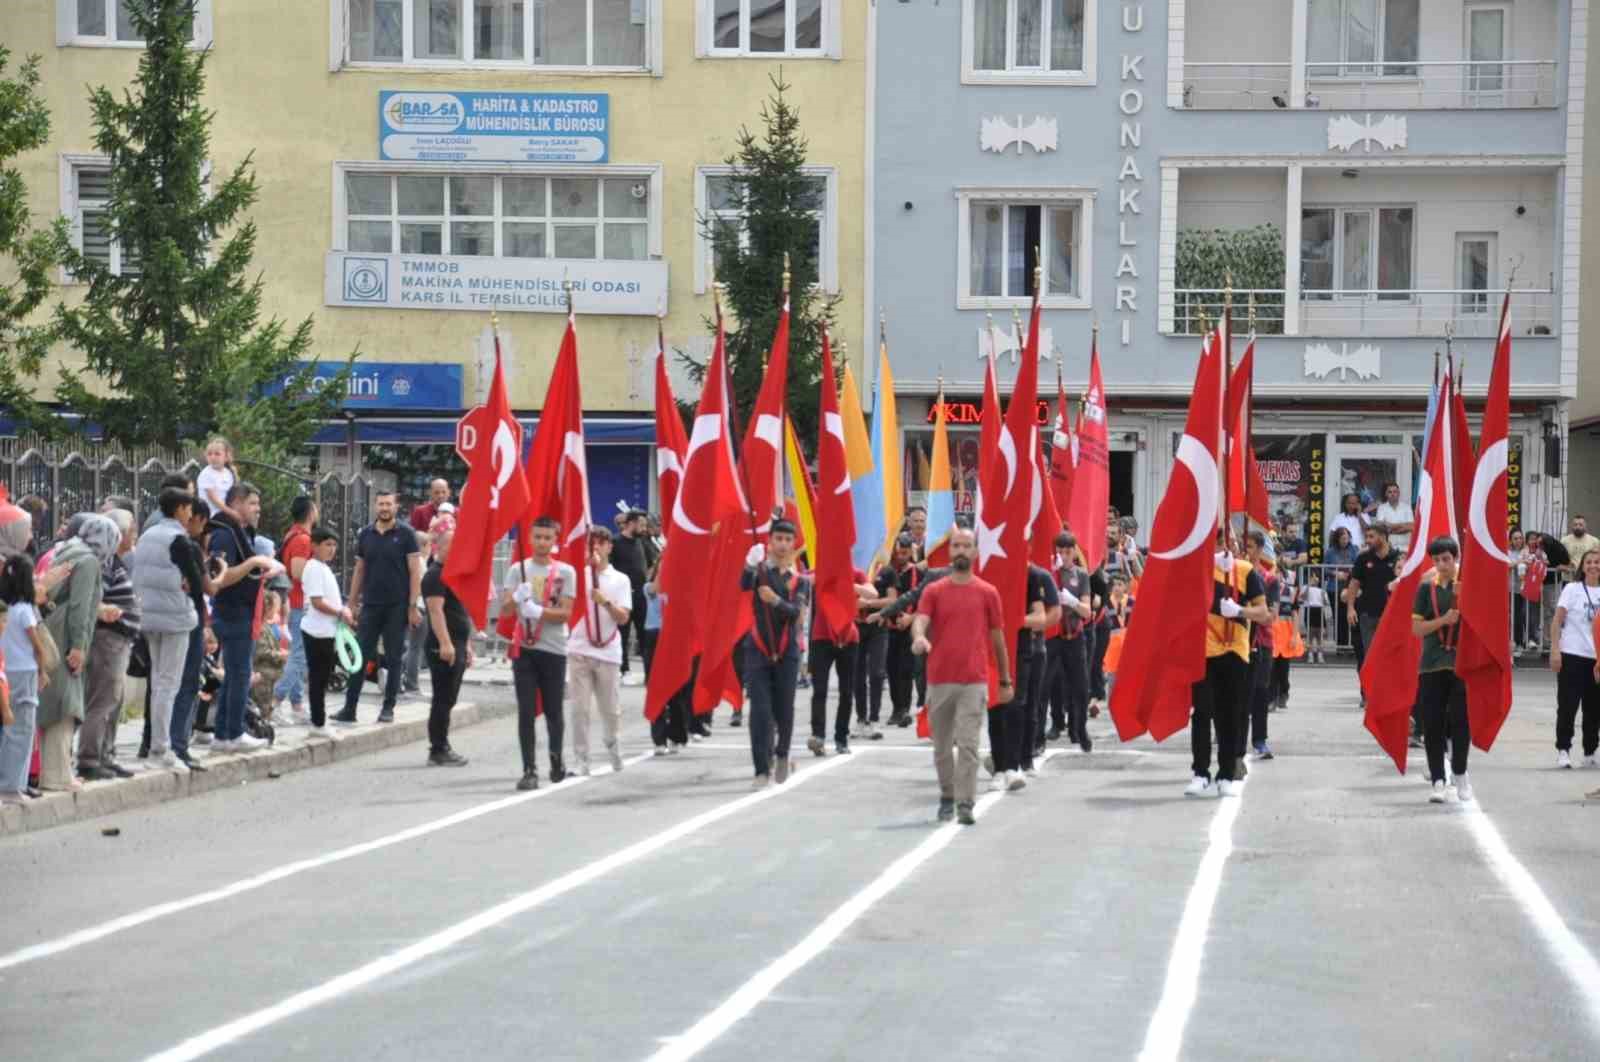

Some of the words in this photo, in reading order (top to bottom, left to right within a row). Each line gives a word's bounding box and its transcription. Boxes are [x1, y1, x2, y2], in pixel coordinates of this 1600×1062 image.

[472, 96, 517, 113] HARİTA
[520, 98, 530, 113] &
[534, 99, 599, 113] KADASTRO
[466, 114, 551, 130] MÜHENDİSLİK
[555, 116, 605, 131] BÜROSU
[1115, 55, 1144, 345] KONAKLARI
[402, 261, 459, 273] TMMOB
[401, 274, 463, 289] MAKİNA
[468, 276, 586, 292] MÜHENDİSLERİ
[592, 281, 641, 293] ODASI
[401, 292, 444, 304] KARS
[450, 290, 464, 304] İL
[470, 291, 572, 307] TEMSİLCİLİĞ
[1310, 450, 1323, 494] FOTO
